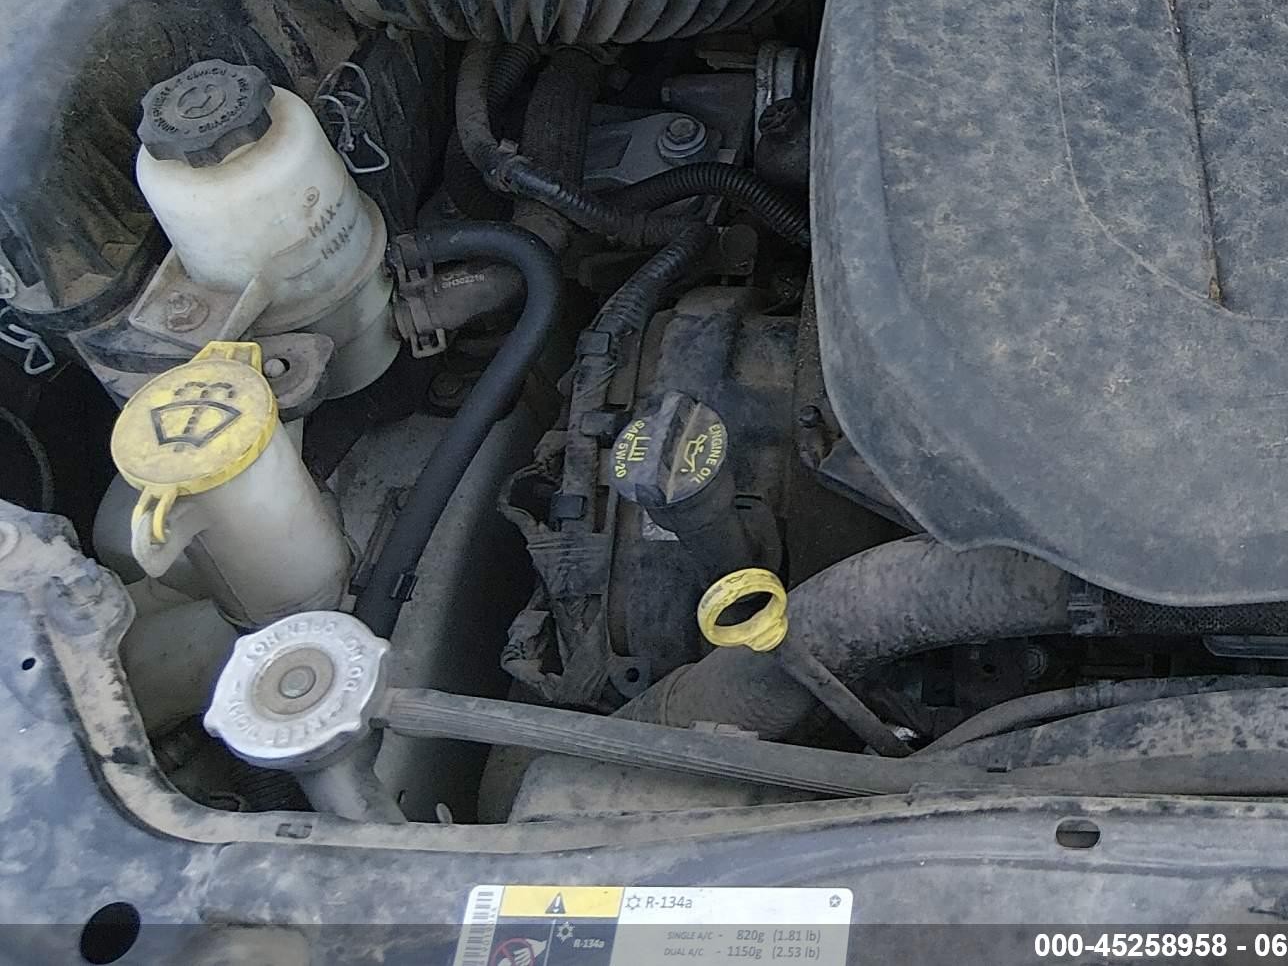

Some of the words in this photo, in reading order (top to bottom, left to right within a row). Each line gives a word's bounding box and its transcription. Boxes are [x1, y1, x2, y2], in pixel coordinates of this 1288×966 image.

[623, 419, 647, 442] SAE
[704, 423, 727, 466] ENGINE
[613, 442, 629, 479] 5W-20
[690, 467, 713, 485] OIL
[645, 895, 693, 910] R-134a
[666, 930, 696, 940] SINGLE
[697, 930, 714, 941] A/C
[736, 930, 766, 944] 820g
[771, 929, 804, 943] (1.81
[805, 928, 822, 943] lb)
[663, 947, 687, 957] DUAL
[688, 947, 705, 957] A/C
[727, 945, 763, 960] 1150g
[771, 945, 803, 960] (2.53
[804, 945, 821, 960] lb)
